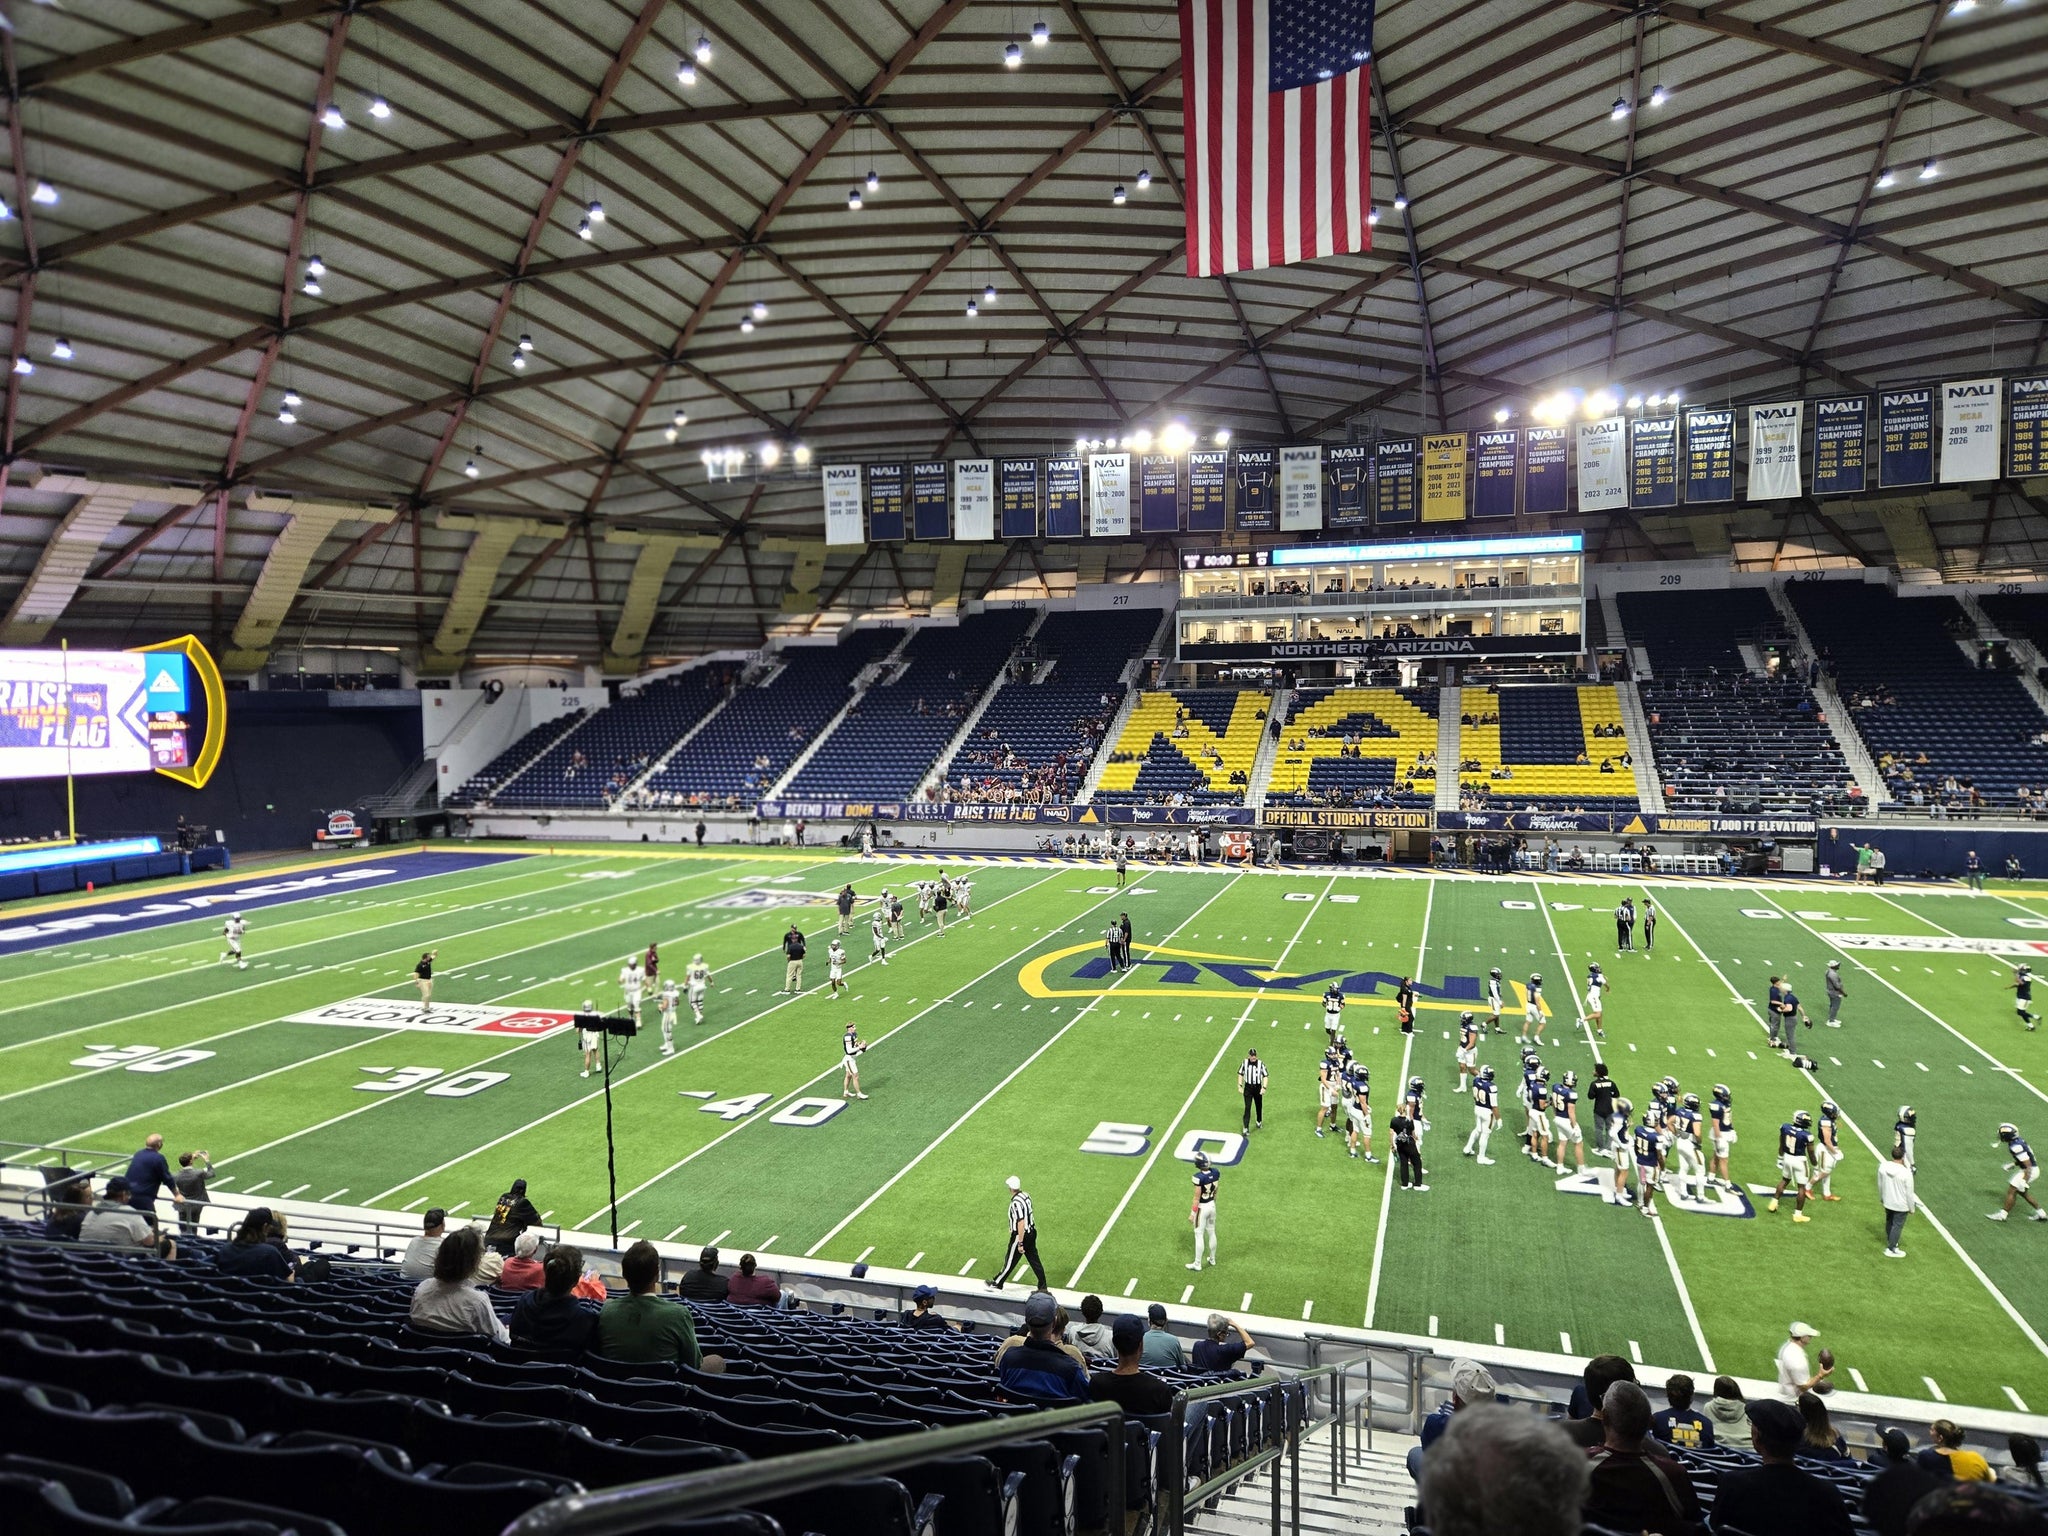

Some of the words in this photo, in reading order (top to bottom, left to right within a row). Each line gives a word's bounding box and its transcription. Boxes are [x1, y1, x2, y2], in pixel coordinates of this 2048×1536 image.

[1949, 385, 1994, 398] NAU
[1884, 392, 1928, 406] NAU
[1820, 401, 1863, 414] NAU
[2014, 404, 2038, 412] REGULAR
[1755, 407, 1796, 420] NAU
[1960, 412, 1982, 421] NCAA
[1691, 414, 1731, 426] NAU
[1885, 415, 1928, 424] TOURNAMENT
[1582, 423, 1618, 436] NAU
[1635, 421, 1674, 433] NAU
[1884, 422, 1929, 432] CHAMPIONS
[1950, 426, 1967, 434] 2019
[1975, 425, 1993, 433] 2021
[2016, 421, 2033, 429] 1987
[1480, 434, 1516, 445] NAU
[1529, 429, 1565, 441] NAU
[1691, 435, 1731, 443] TOURNAMENT
[1819, 430, 1862, 440] CHAMPIONS
[1886, 434, 1903, 442] 1997
[1910, 432, 1927, 440] 2019
[2015, 432, 2033, 440] 1989
[1428, 439, 1461, 450] NAU
[1949, 437, 1968, 445] 2026
[1379, 443, 1412, 454] NAU
[1690, 442, 1731, 451] CHAMPIONS
[1886, 444, 1902, 452] 2021
[2014, 443, 2032, 451] 1994
[1239, 453, 1272, 462] NAU
[1284, 451, 1316, 461] NAU
[1331, 448, 1365, 458] NAU
[1635, 449, 1674, 457] CHAMPIONS
[1844, 449, 1862, 457] 2023
[2014, 453, 2032, 461] 2014
[1143, 456, 1174, 465] NAU
[1191, 454, 1224, 464] NAU
[1479, 460, 1513, 468] CHAMPIONS
[1529, 456, 1565, 464] CHAMPIONS
[1819, 460, 1837, 468] 2024
[914, 465, 944, 474] NAU
[959, 465, 988, 473] NAU
[1004, 463, 1034, 472] NAU
[1048, 462, 1078, 471] NAU
[1583, 461, 1600, 469] 2006
[1692, 462, 1707, 470] 1999
[2014, 464, 2031, 472] 2016
[828, 470, 856, 478] NAU
[870, 467, 900, 476] NAU
[1379, 468, 1412, 477] CHAMPIONS
[1712, 470, 1730, 478] 2022
[1656, 476, 1673, 484] 2023
[1605, 488, 1622, 496] 2024
[1660, 574, 1681, 585] 209
[1999, 583, 2022, 595] 205
[1012, 600, 1026, 609] 219
[1113, 595, 1128, 606] 217
[1384, 640, 1474, 653] ARIZONA
[561, 697, 580, 706] 225
[18, 715, 39, 729] THE
[40, 715, 108, 746] FLAG
[786, 804, 822, 816] DEFEND
[825, 804, 844, 816] THE
[845, 804, 874, 817] DOME
[908, 804, 947, 814] CREST
[954, 806, 984, 819] RAISE
[987, 806, 1006, 819] THE
[1009, 806, 1036, 820] FLAG
[1266, 812, 1315, 824] OFFICIAL
[1318, 812, 1372, 826] STUDENT
[1375, 813, 1425, 827] SECTION
[1658, 819, 1711, 831] WARNING!
[1712, 820, 1742, 831] 7,000
[1743, 821, 1756, 831] FT
[1758, 821, 1815, 832] ELEVATION
[1232, 845, 1241, 856] G
[318, 1009, 478, 1026] TOYOTA
[70, 1046, 216, 1071] 20
[352, 1066, 511, 1097] 30
[1554, 1092, 1565, 1111] 15
[698, 1093, 849, 1127] 40
[1079, 1121, 1249, 1166] 50
[1636, 1140, 1649, 1156] 11
[1555, 1168, 1755, 1218] 40
